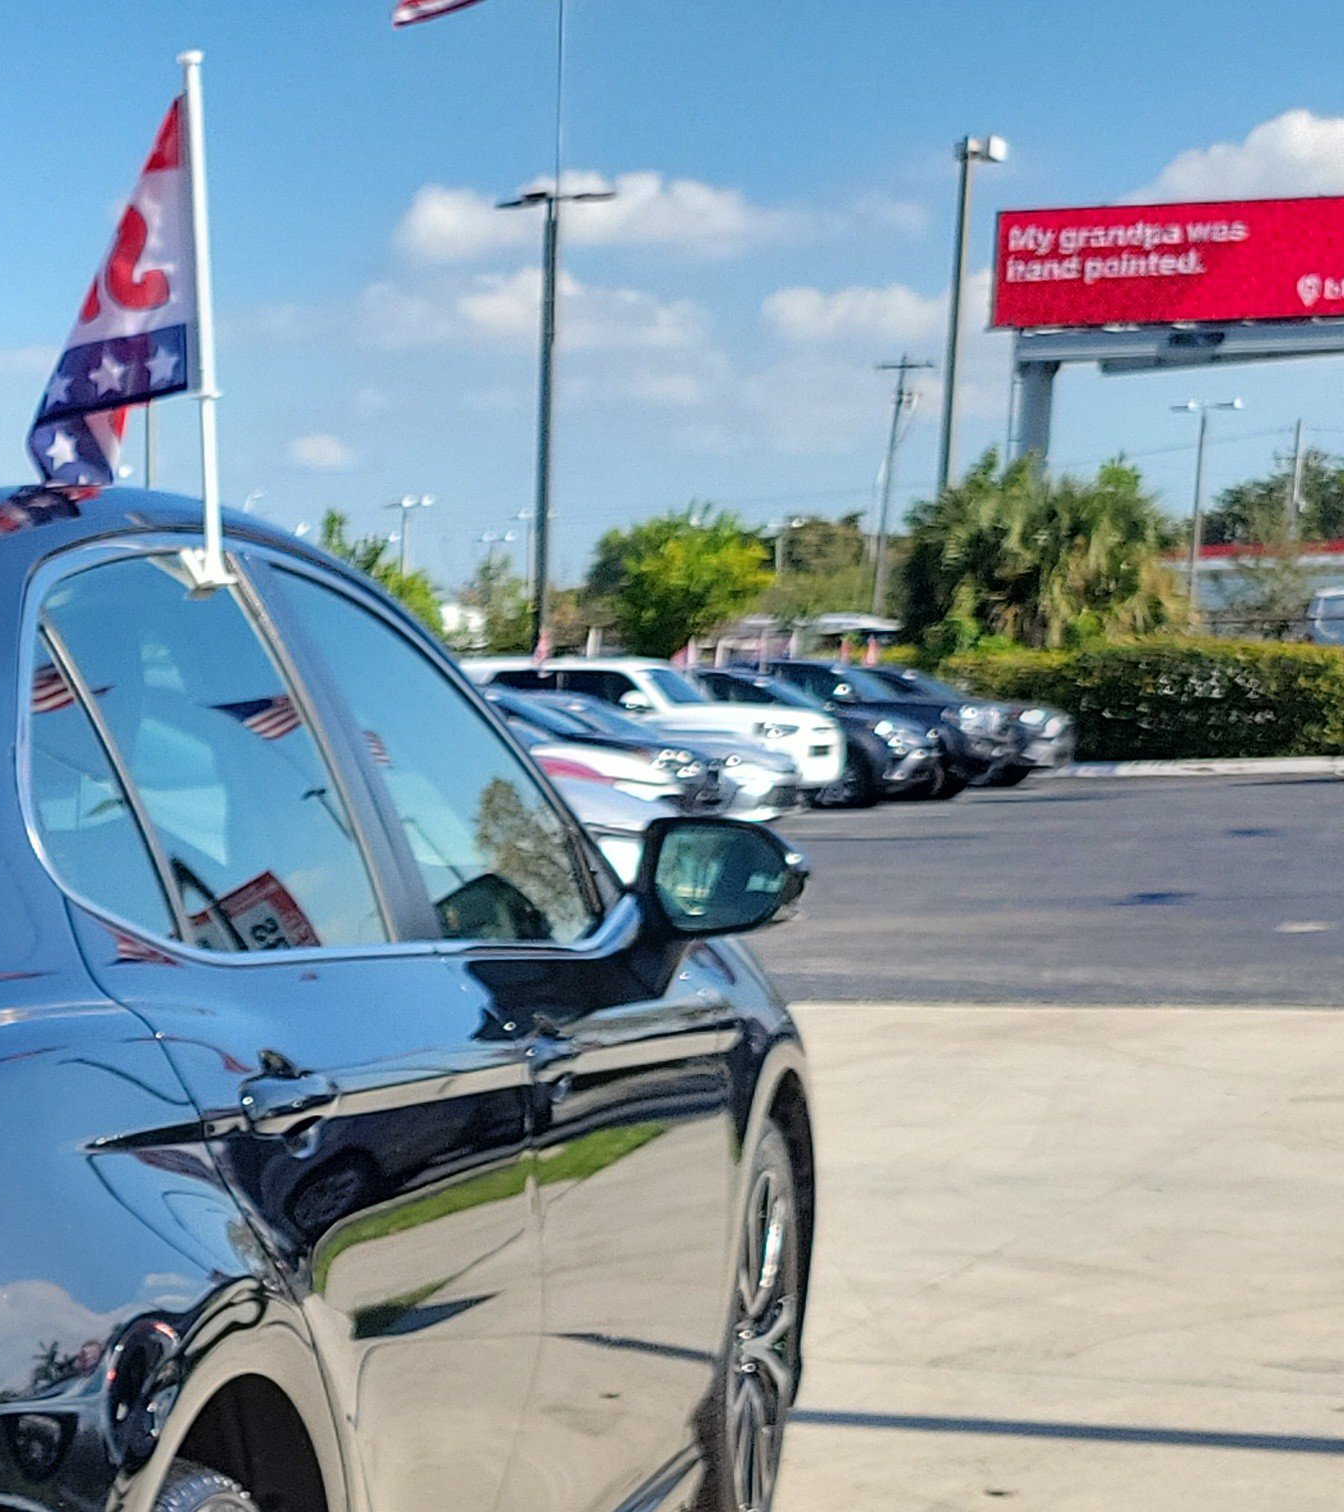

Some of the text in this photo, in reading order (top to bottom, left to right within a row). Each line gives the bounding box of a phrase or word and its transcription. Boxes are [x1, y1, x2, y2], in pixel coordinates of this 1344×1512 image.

[1008, 219, 1250, 255] My grandpa was
[1006, 248, 1206, 284] hand painted.
